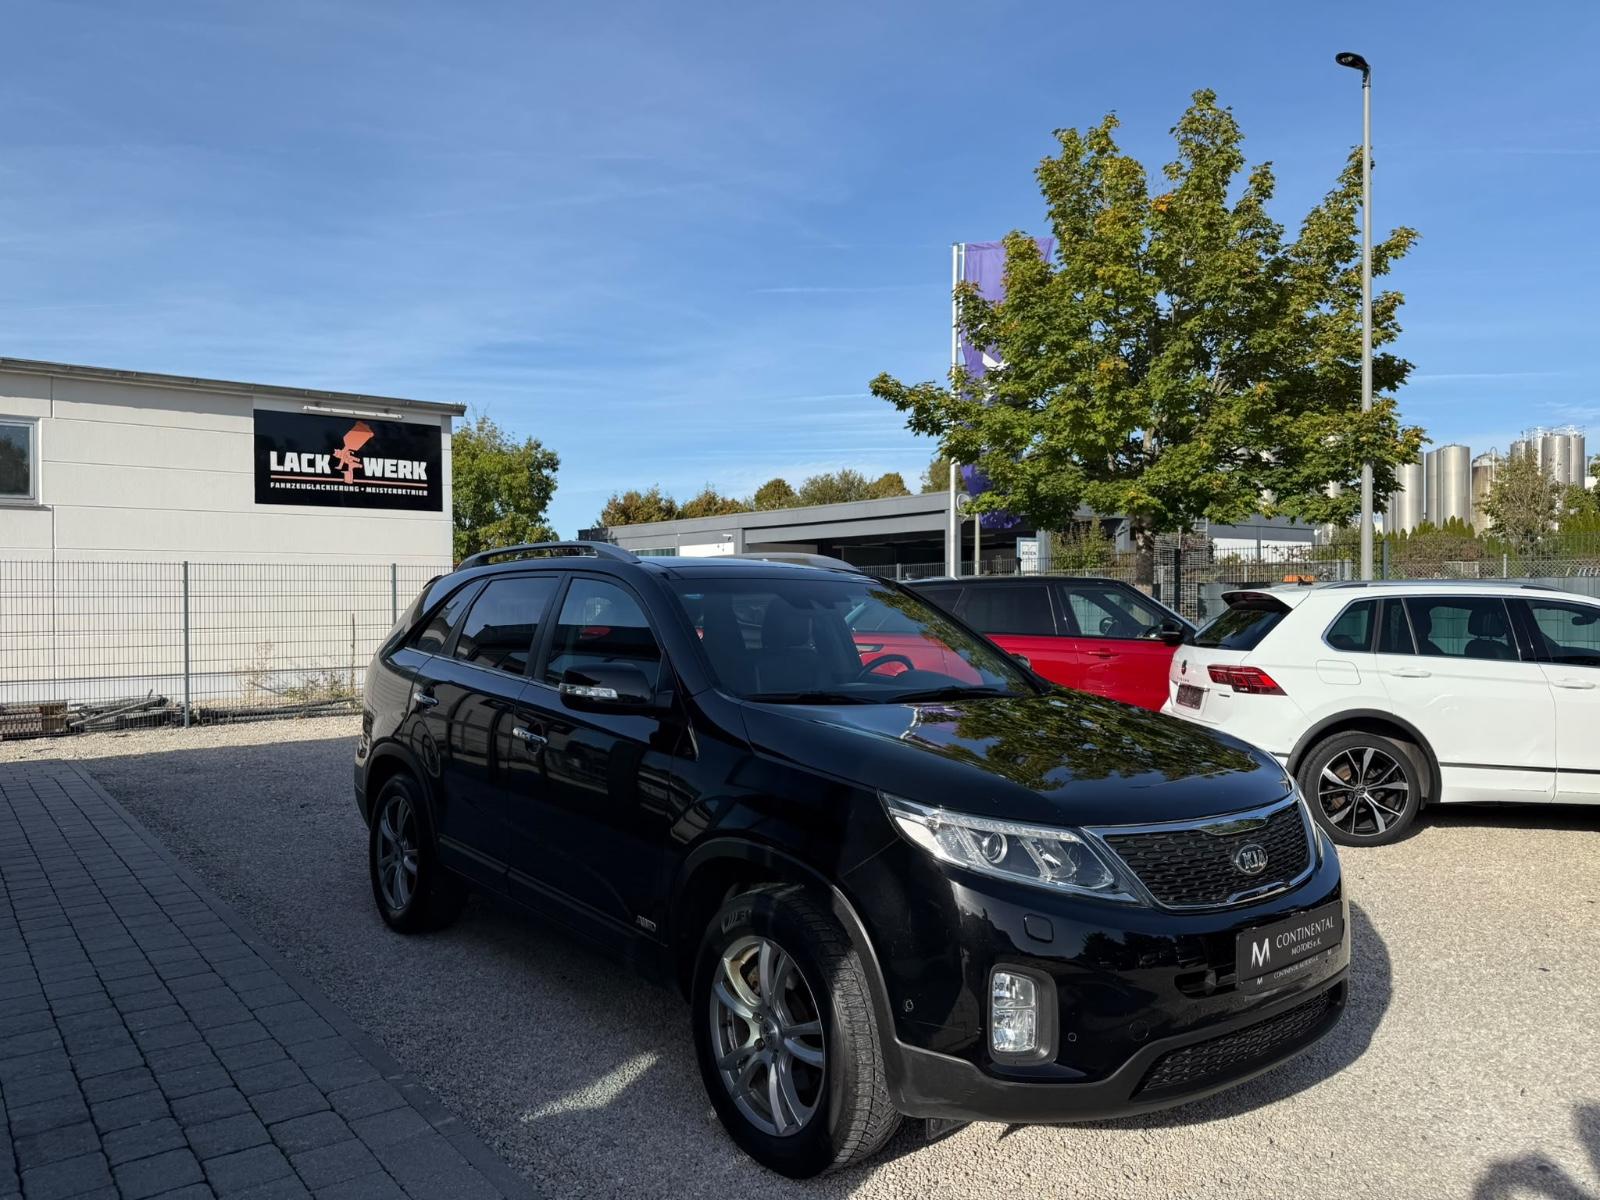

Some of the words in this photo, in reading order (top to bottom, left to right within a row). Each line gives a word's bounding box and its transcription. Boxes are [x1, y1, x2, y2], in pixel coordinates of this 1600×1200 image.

[270, 450, 331, 474] LACK
[363, 457, 427, 480] WERK
[270, 482, 359, 492] FAHRZEUGLACKIERUNG
[365, 486, 428, 496] MEISTERBETRIEB
[1276, 916, 1335, 948] CONTINENTAL
[1291, 940, 1313, 956] MOTORS
